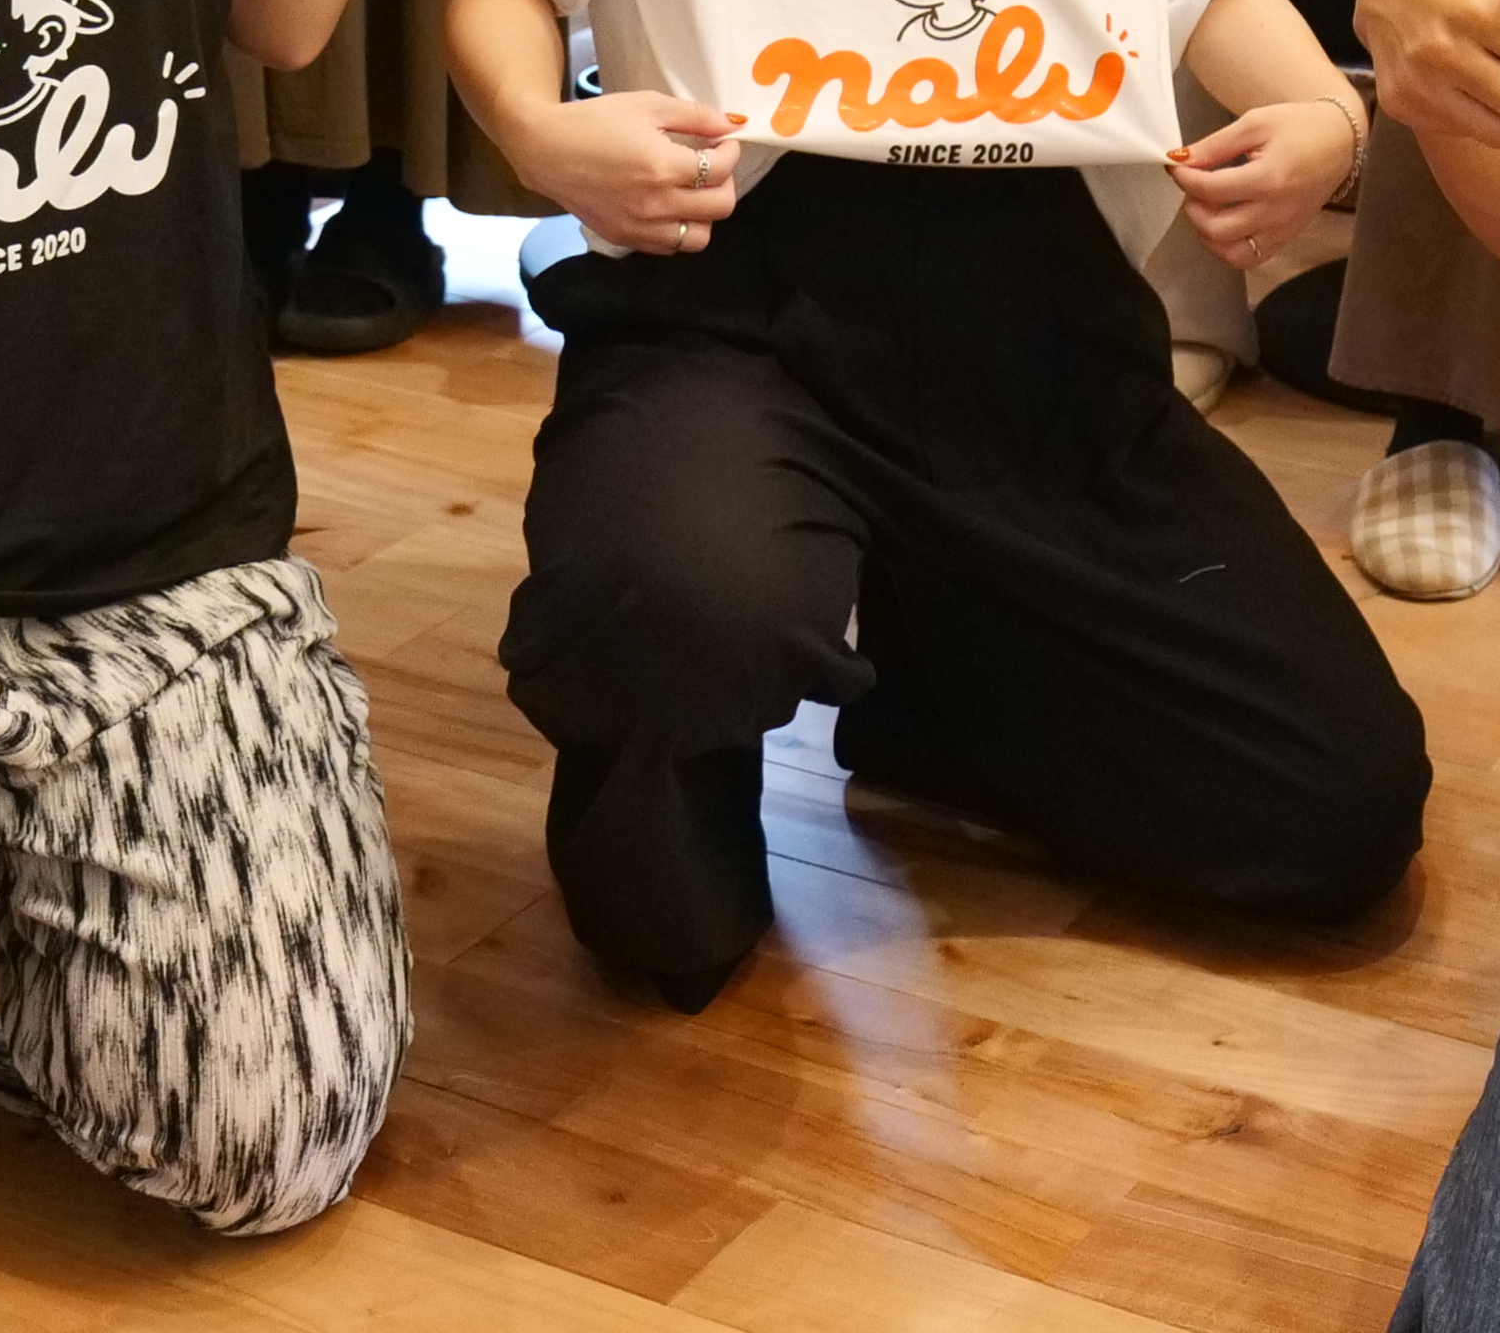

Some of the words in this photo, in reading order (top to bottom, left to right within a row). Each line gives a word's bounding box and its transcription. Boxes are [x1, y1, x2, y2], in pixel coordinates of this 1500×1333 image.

[751, 4, 1126, 138] nalu
[887, 144, 961, 165] SINCE
[972, 141, 1034, 165] 2020
[31, 226, 87, 266] 2020
